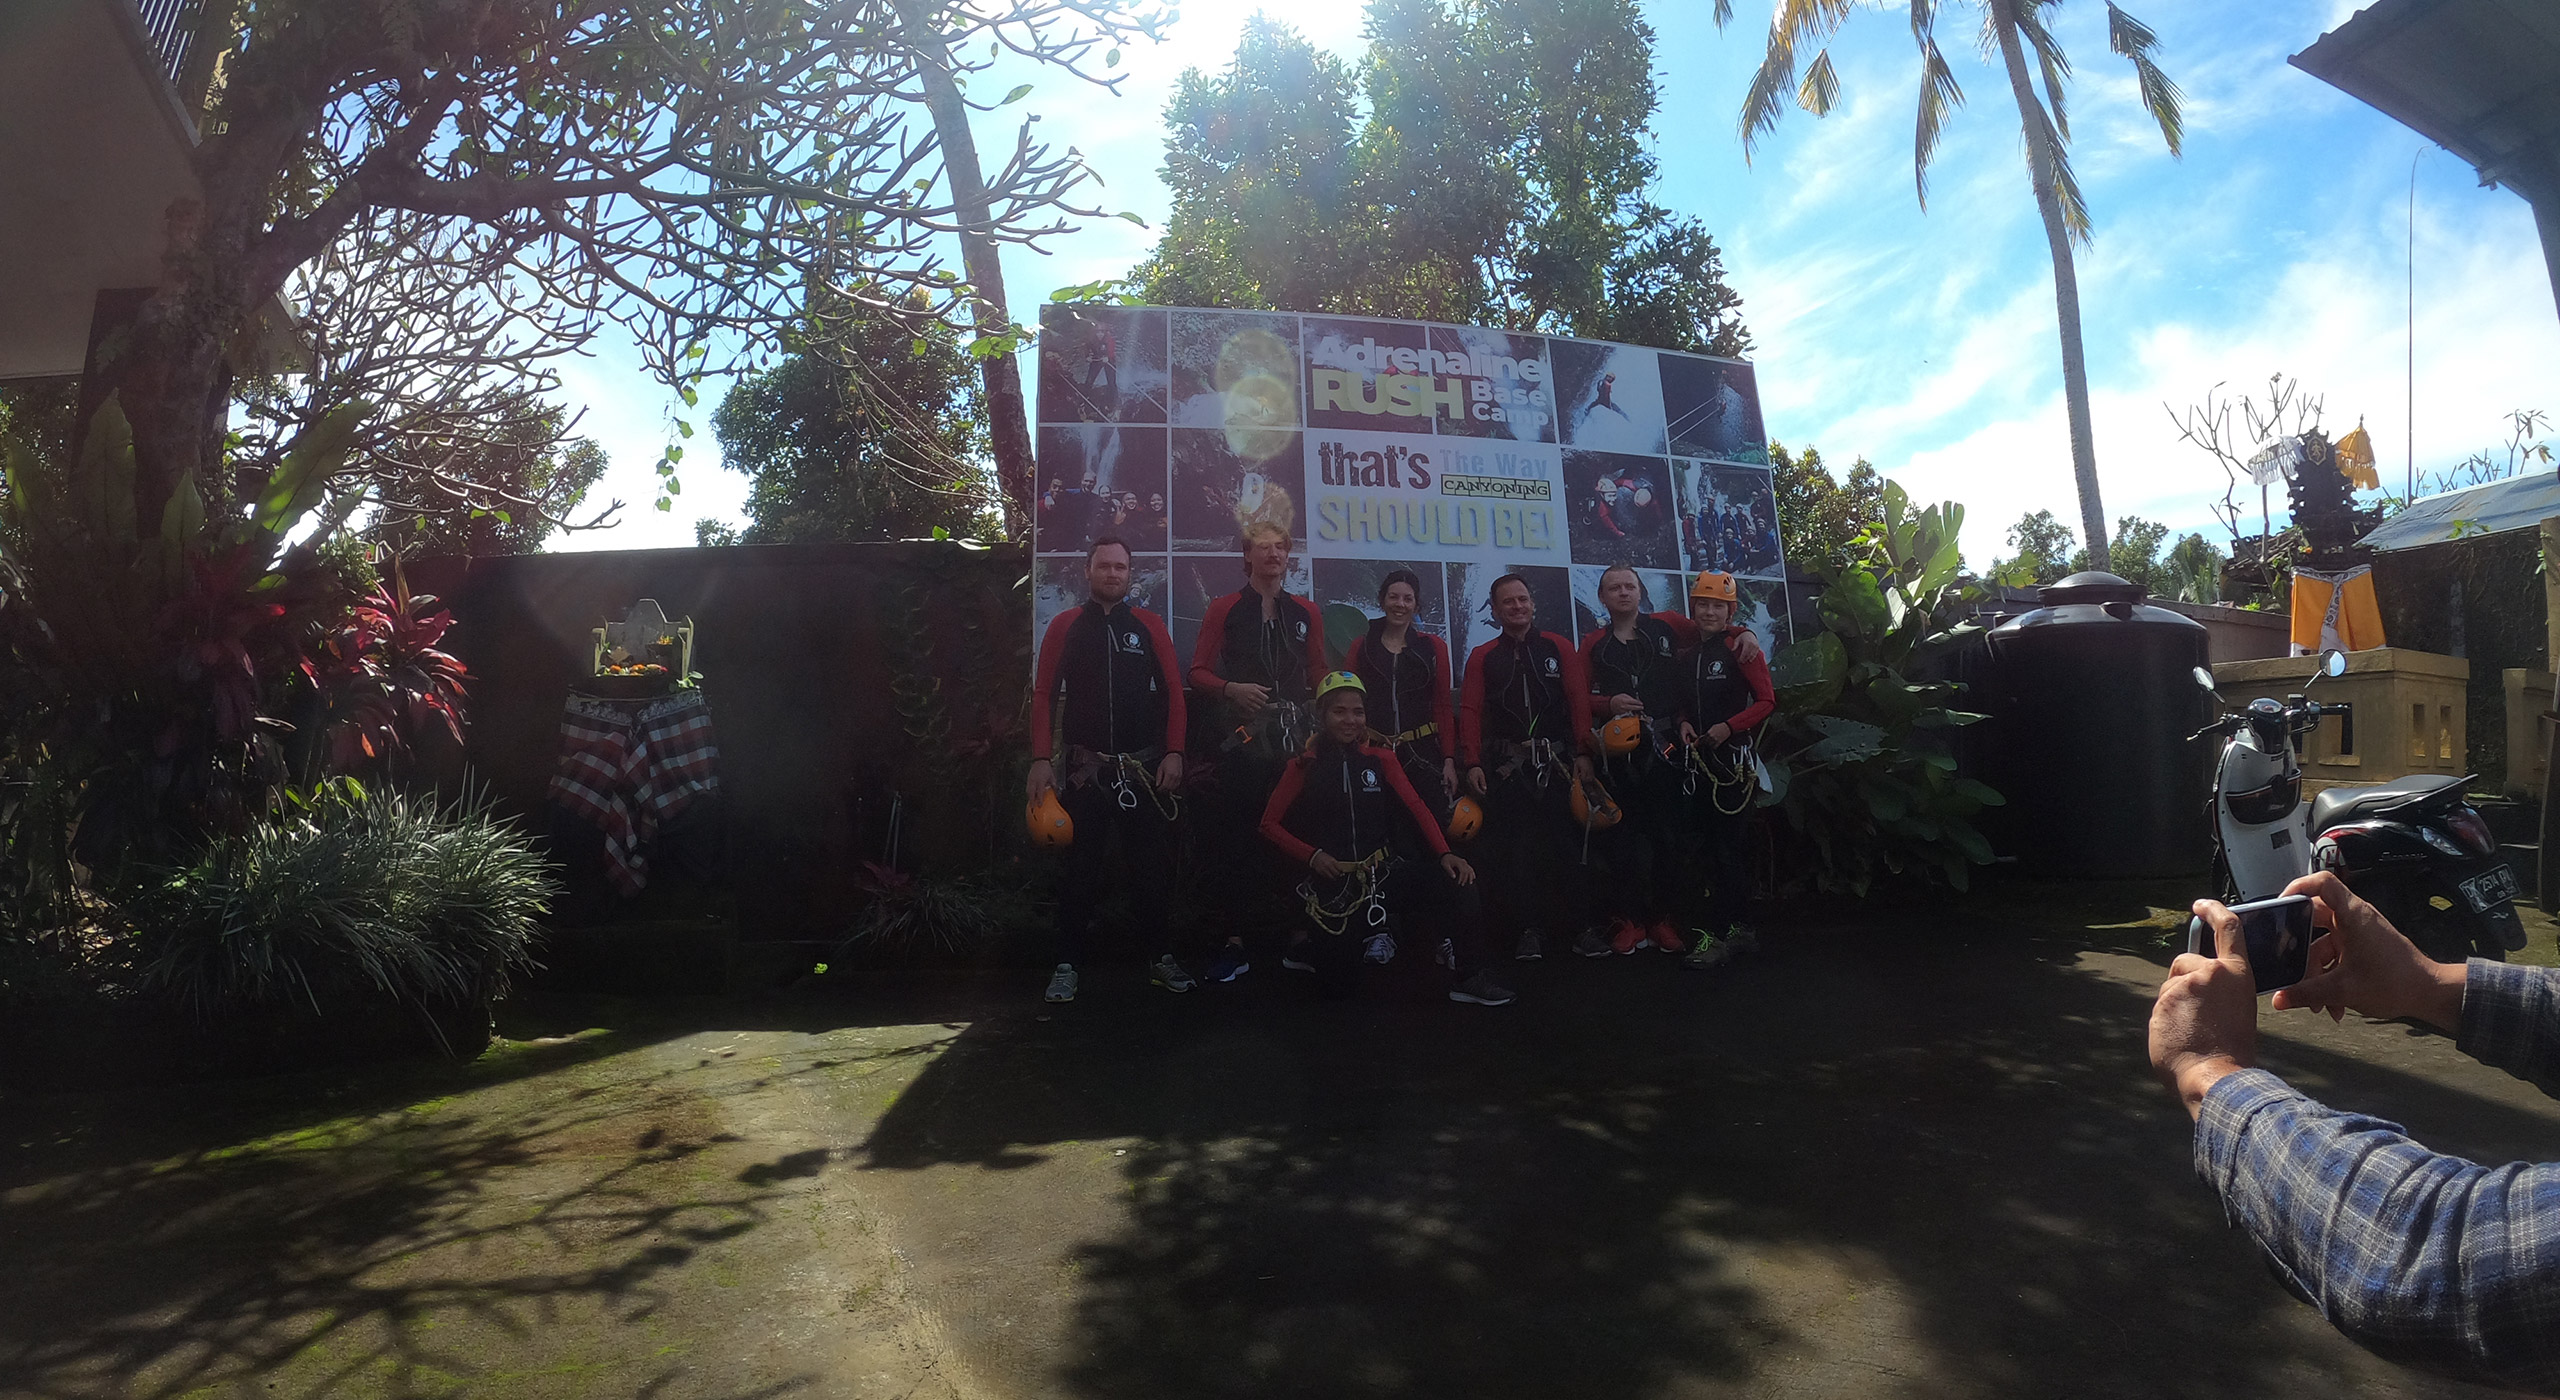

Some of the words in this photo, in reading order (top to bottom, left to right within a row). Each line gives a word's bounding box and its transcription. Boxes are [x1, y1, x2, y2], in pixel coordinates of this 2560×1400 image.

[1312, 337, 1542, 382] Adrenaline
[1312, 369, 1465, 420] RUSH
[1470, 380, 1547, 406] Base
[1472, 402, 1549, 429] Camp
[1318, 442, 1431, 490] that's
[1440, 449, 1485, 475] The
[1494, 453, 1548, 479] Way
[1444, 478, 1549, 496] CANYONING
[1317, 496, 1488, 547] SHOULD
